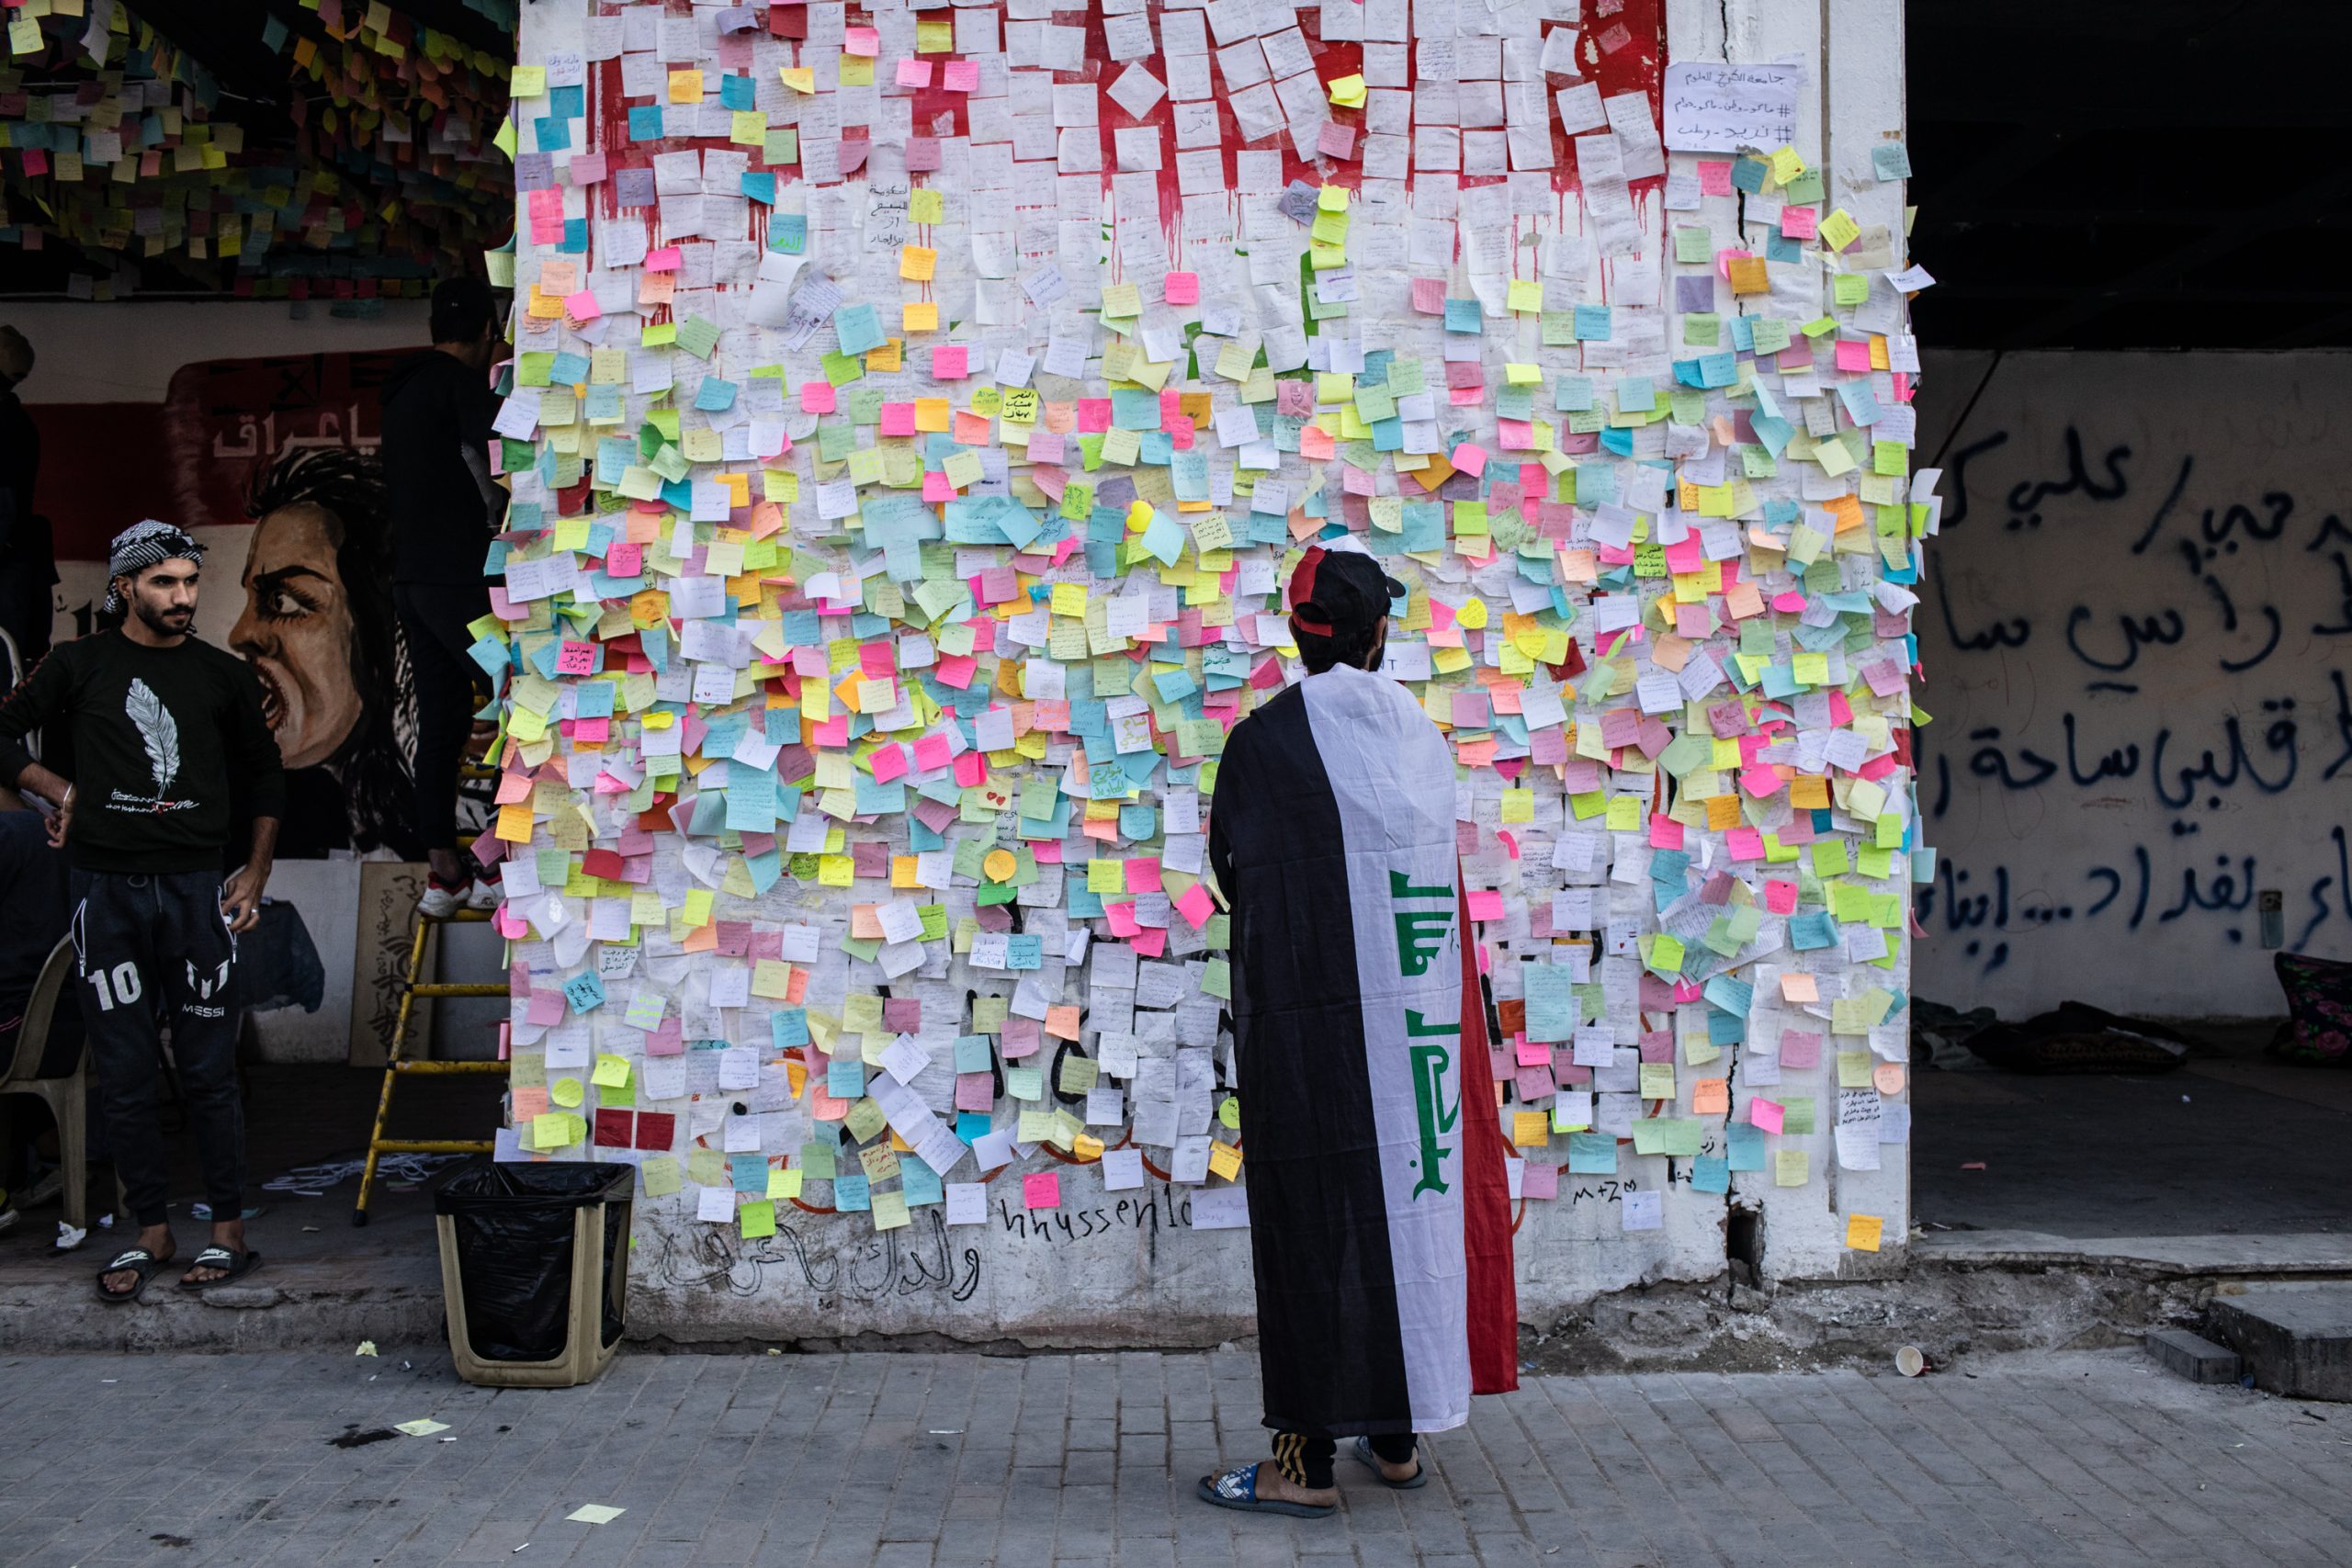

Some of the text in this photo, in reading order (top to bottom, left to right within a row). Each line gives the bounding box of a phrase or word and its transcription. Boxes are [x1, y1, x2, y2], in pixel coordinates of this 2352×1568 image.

[1685, 72, 1712, 85] للعلوم
[1747, 73, 1785, 85] جامعة
[1966, 712, 2140, 789] ساحة
[85, 961, 142, 1011] 10
